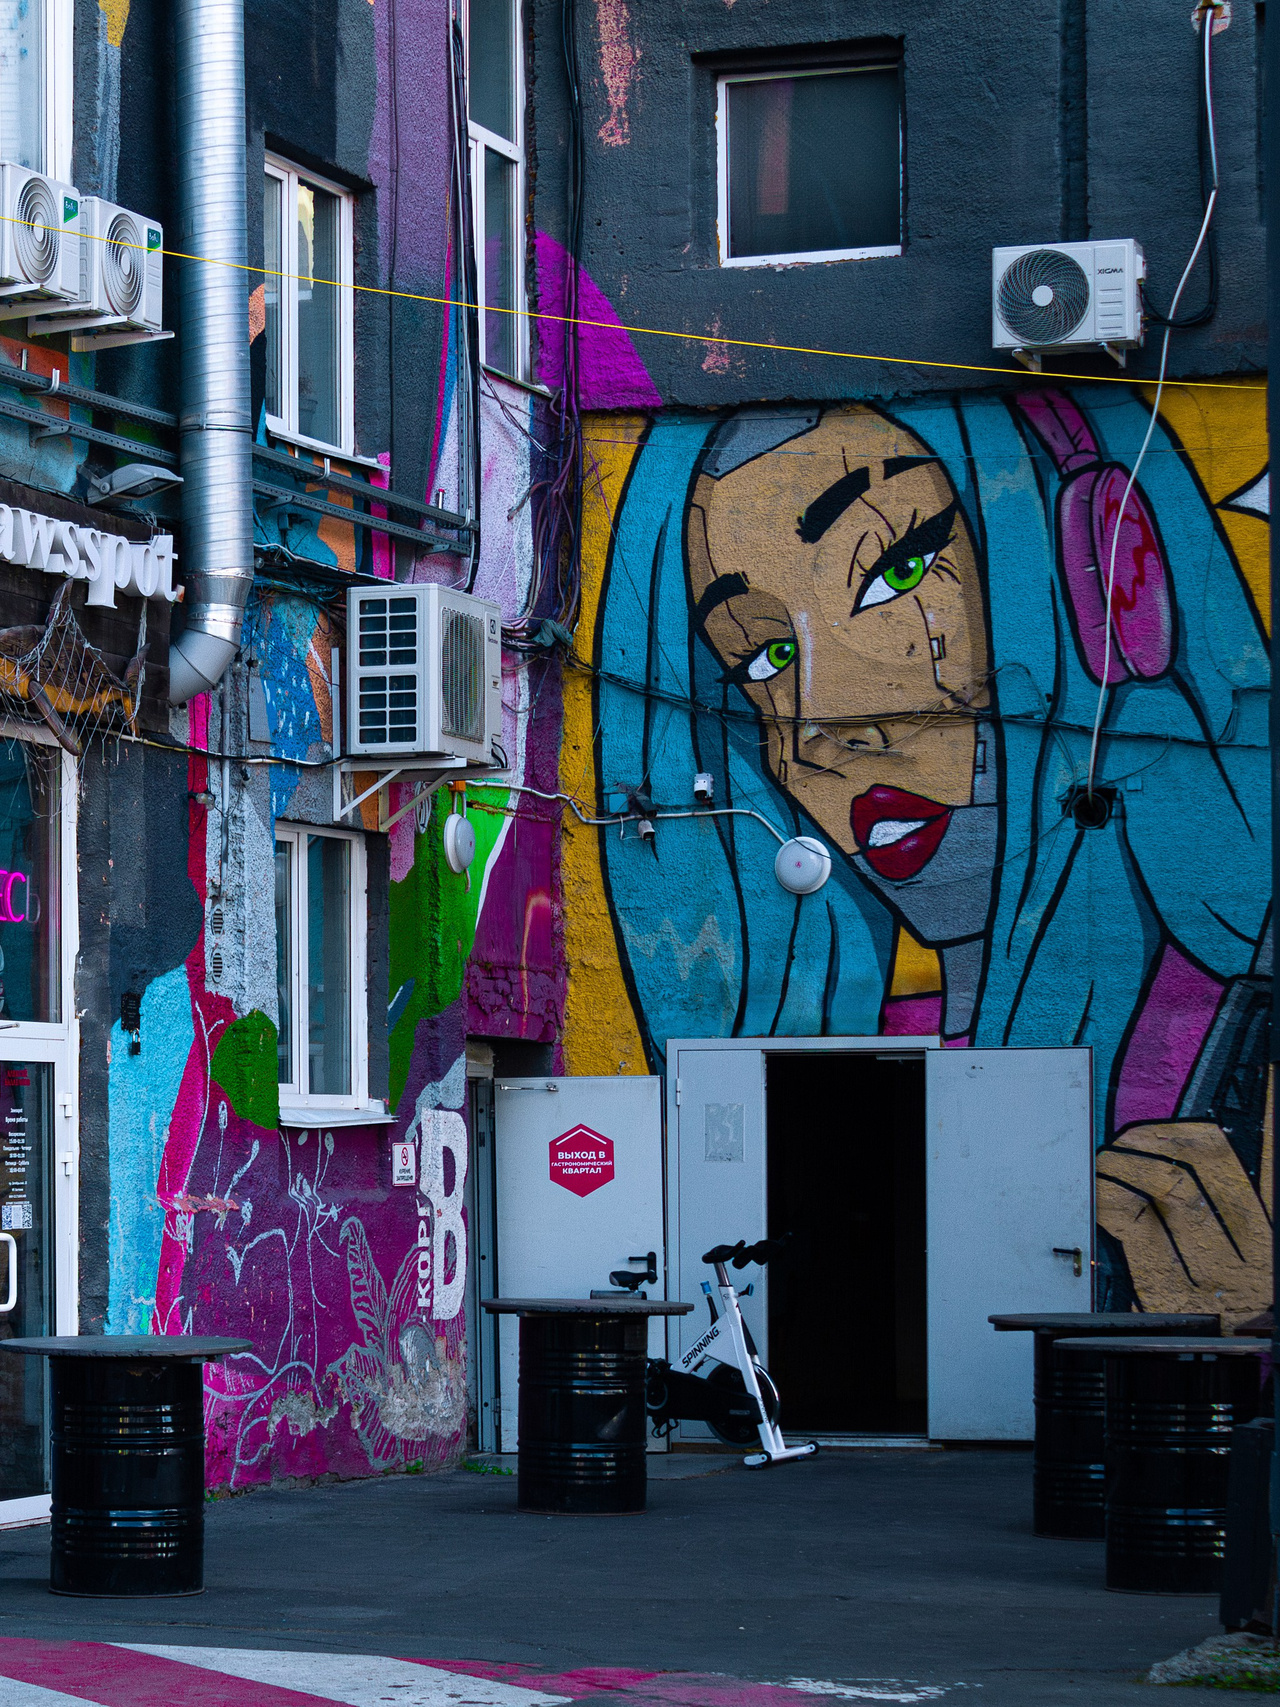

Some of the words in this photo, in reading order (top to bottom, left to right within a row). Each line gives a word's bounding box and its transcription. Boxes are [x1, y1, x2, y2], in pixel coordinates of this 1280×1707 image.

[1097, 267, 1124, 275] XIGMA
[557, 1151, 597, 1160] ВЫХОД
[598, 1151, 606, 1159] В
[562, 1167, 602, 1175] КВАРТАЛ
[682, 1326, 721, 1369] SPINNING
